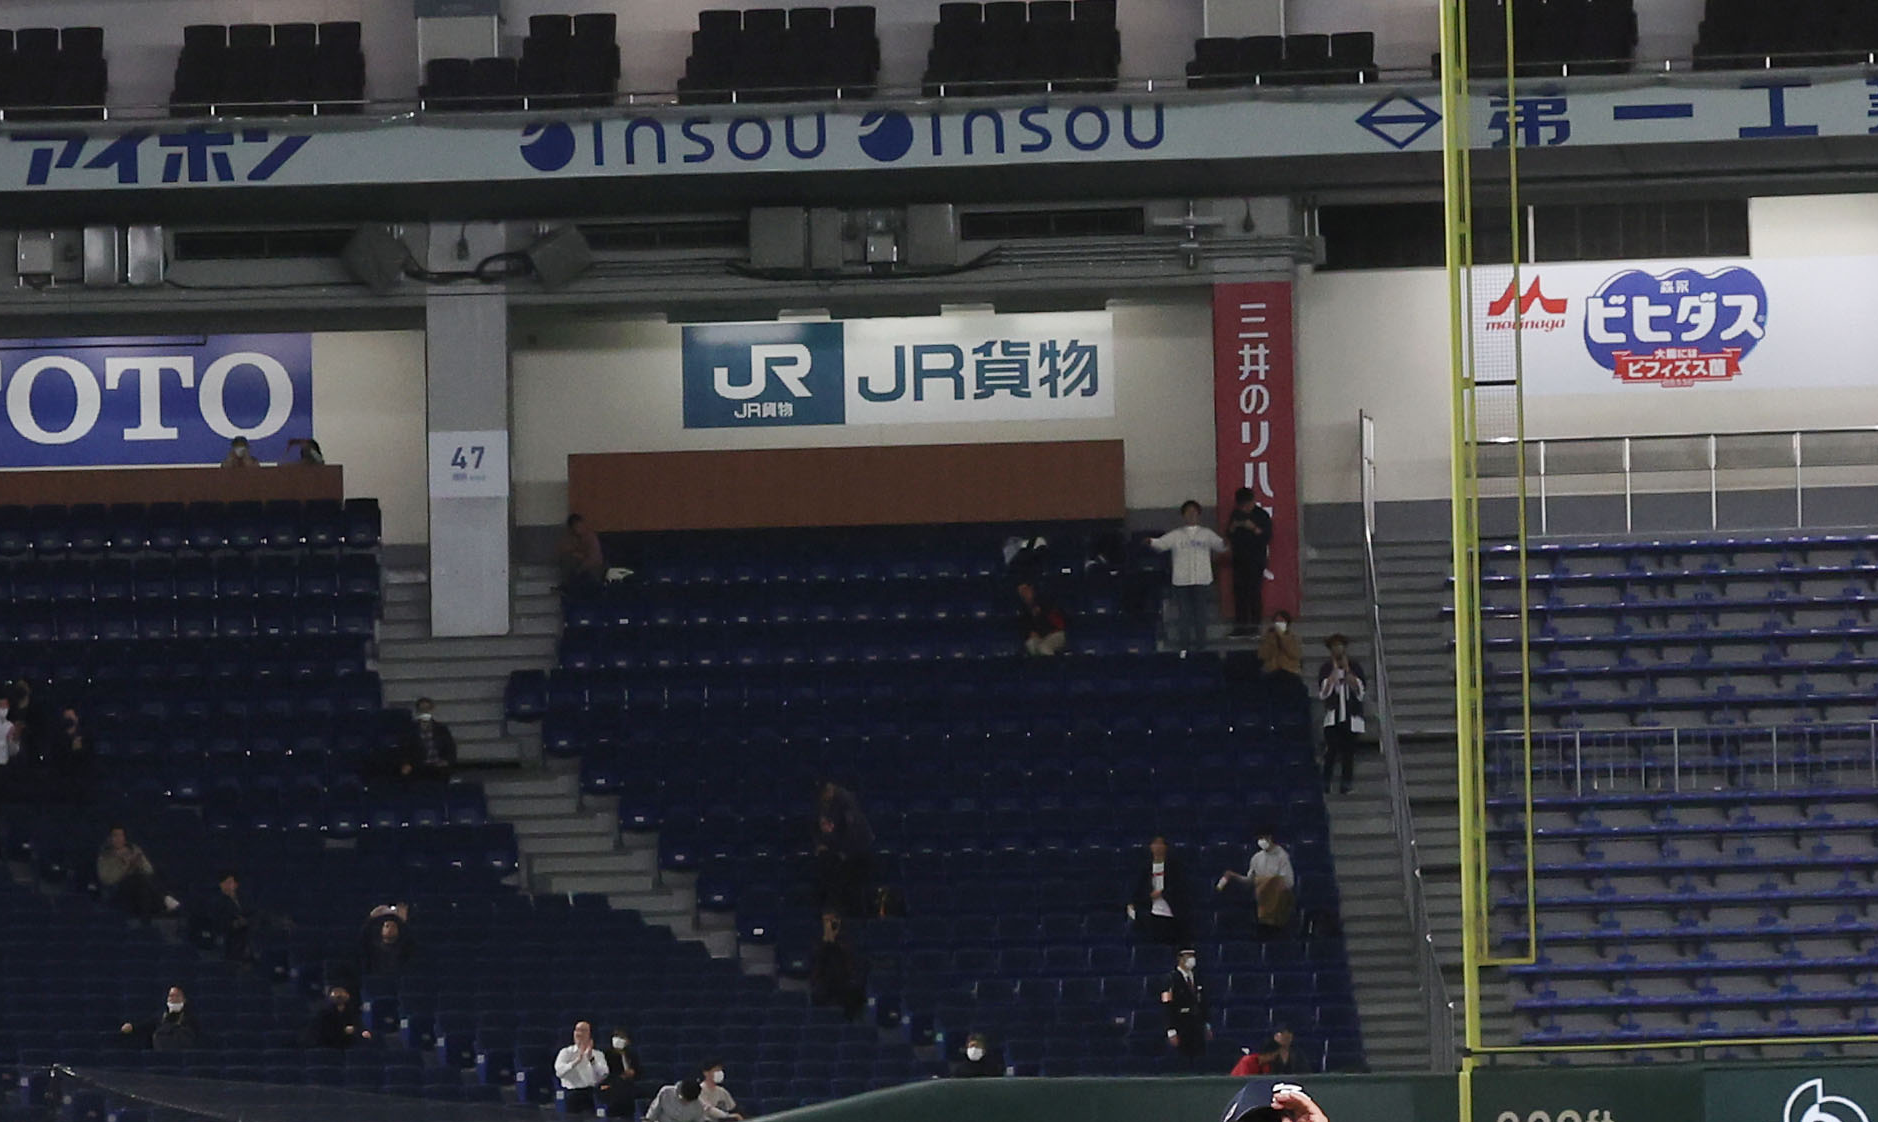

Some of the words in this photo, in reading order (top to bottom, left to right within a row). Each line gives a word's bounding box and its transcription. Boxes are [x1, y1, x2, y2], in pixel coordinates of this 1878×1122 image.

[1586, 291, 1765, 344] ビヒダス
[713, 343, 814, 400] JR
[858, 338, 1099, 403] JR貨物
[734, 401, 793, 419] JR貨物
[451, 446, 485, 469] 47
